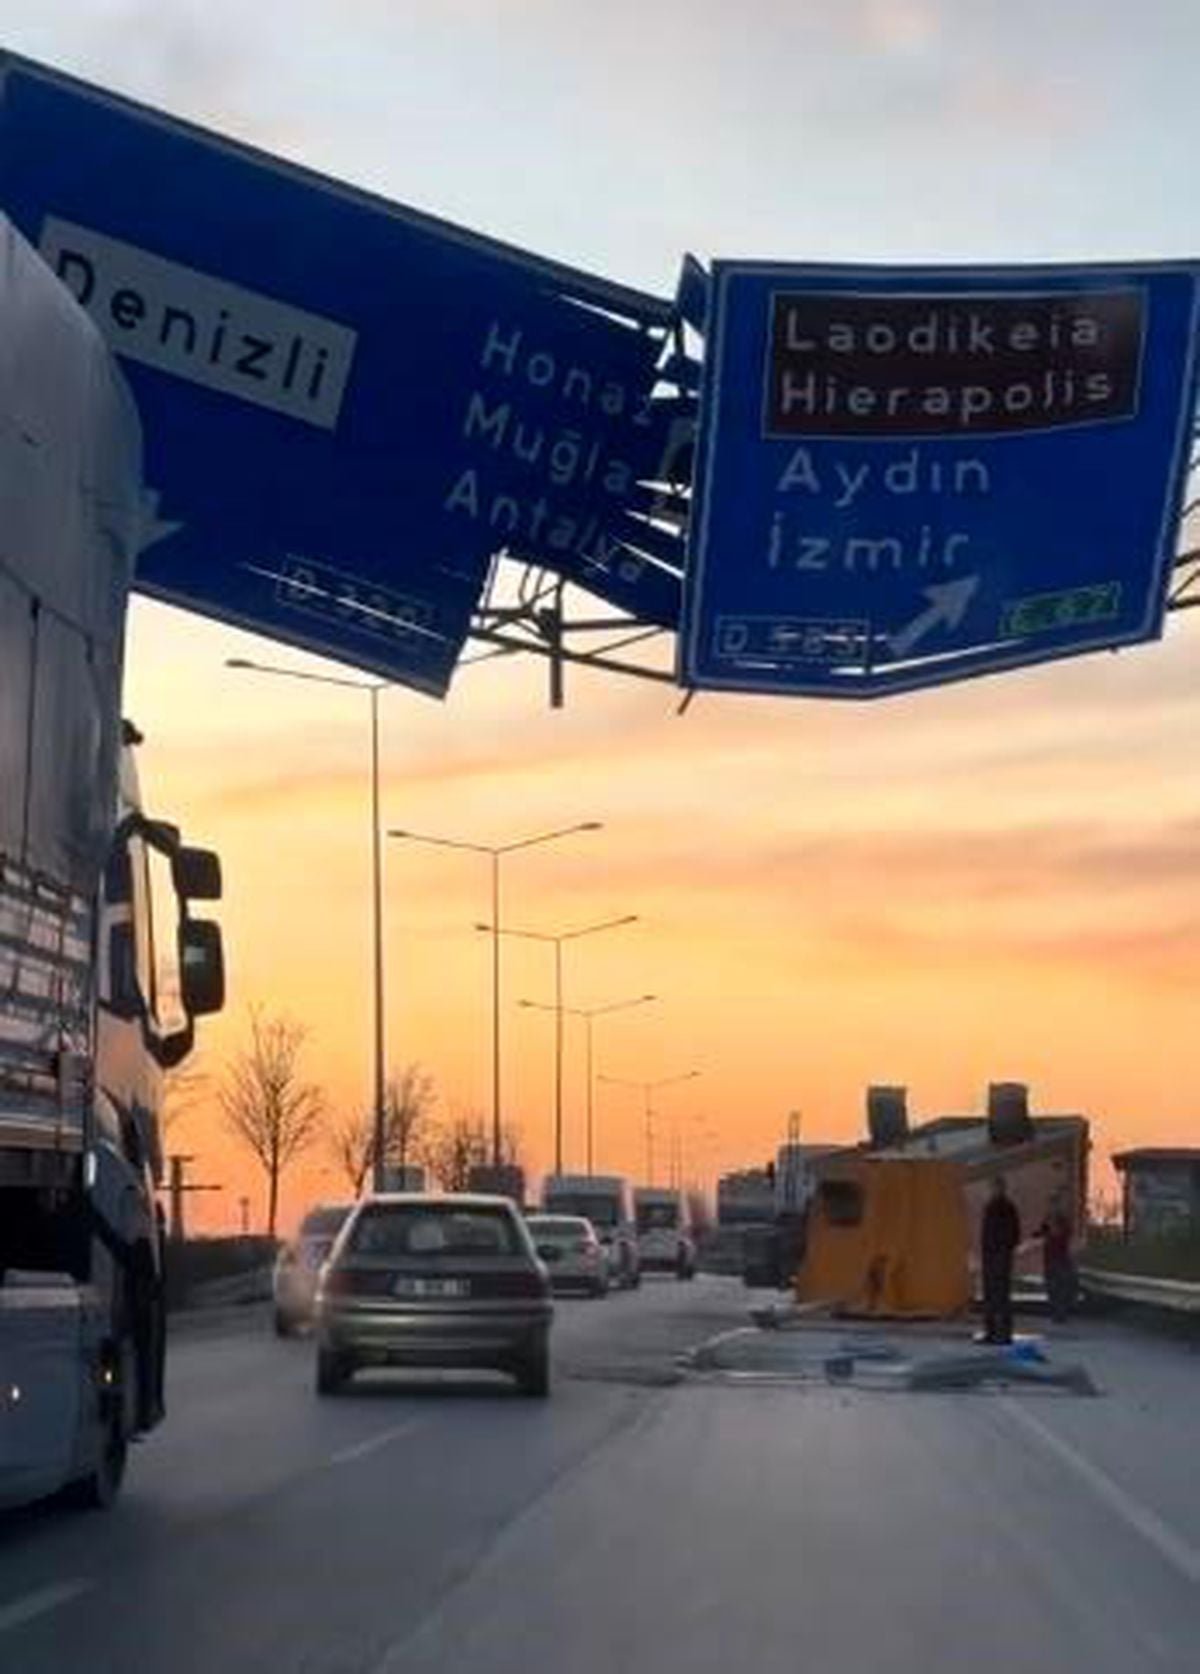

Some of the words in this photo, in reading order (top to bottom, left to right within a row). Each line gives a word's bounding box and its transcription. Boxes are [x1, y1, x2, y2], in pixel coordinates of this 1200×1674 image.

[56, 249, 331, 399] Denizli
[786, 309, 1099, 353] Laodikeia
[781, 370, 1111, 423] Hierapolis
[464, 391, 632, 493] Muğla
[776, 446, 991, 508] Aydın
[769, 511, 969, 571] İzmir
